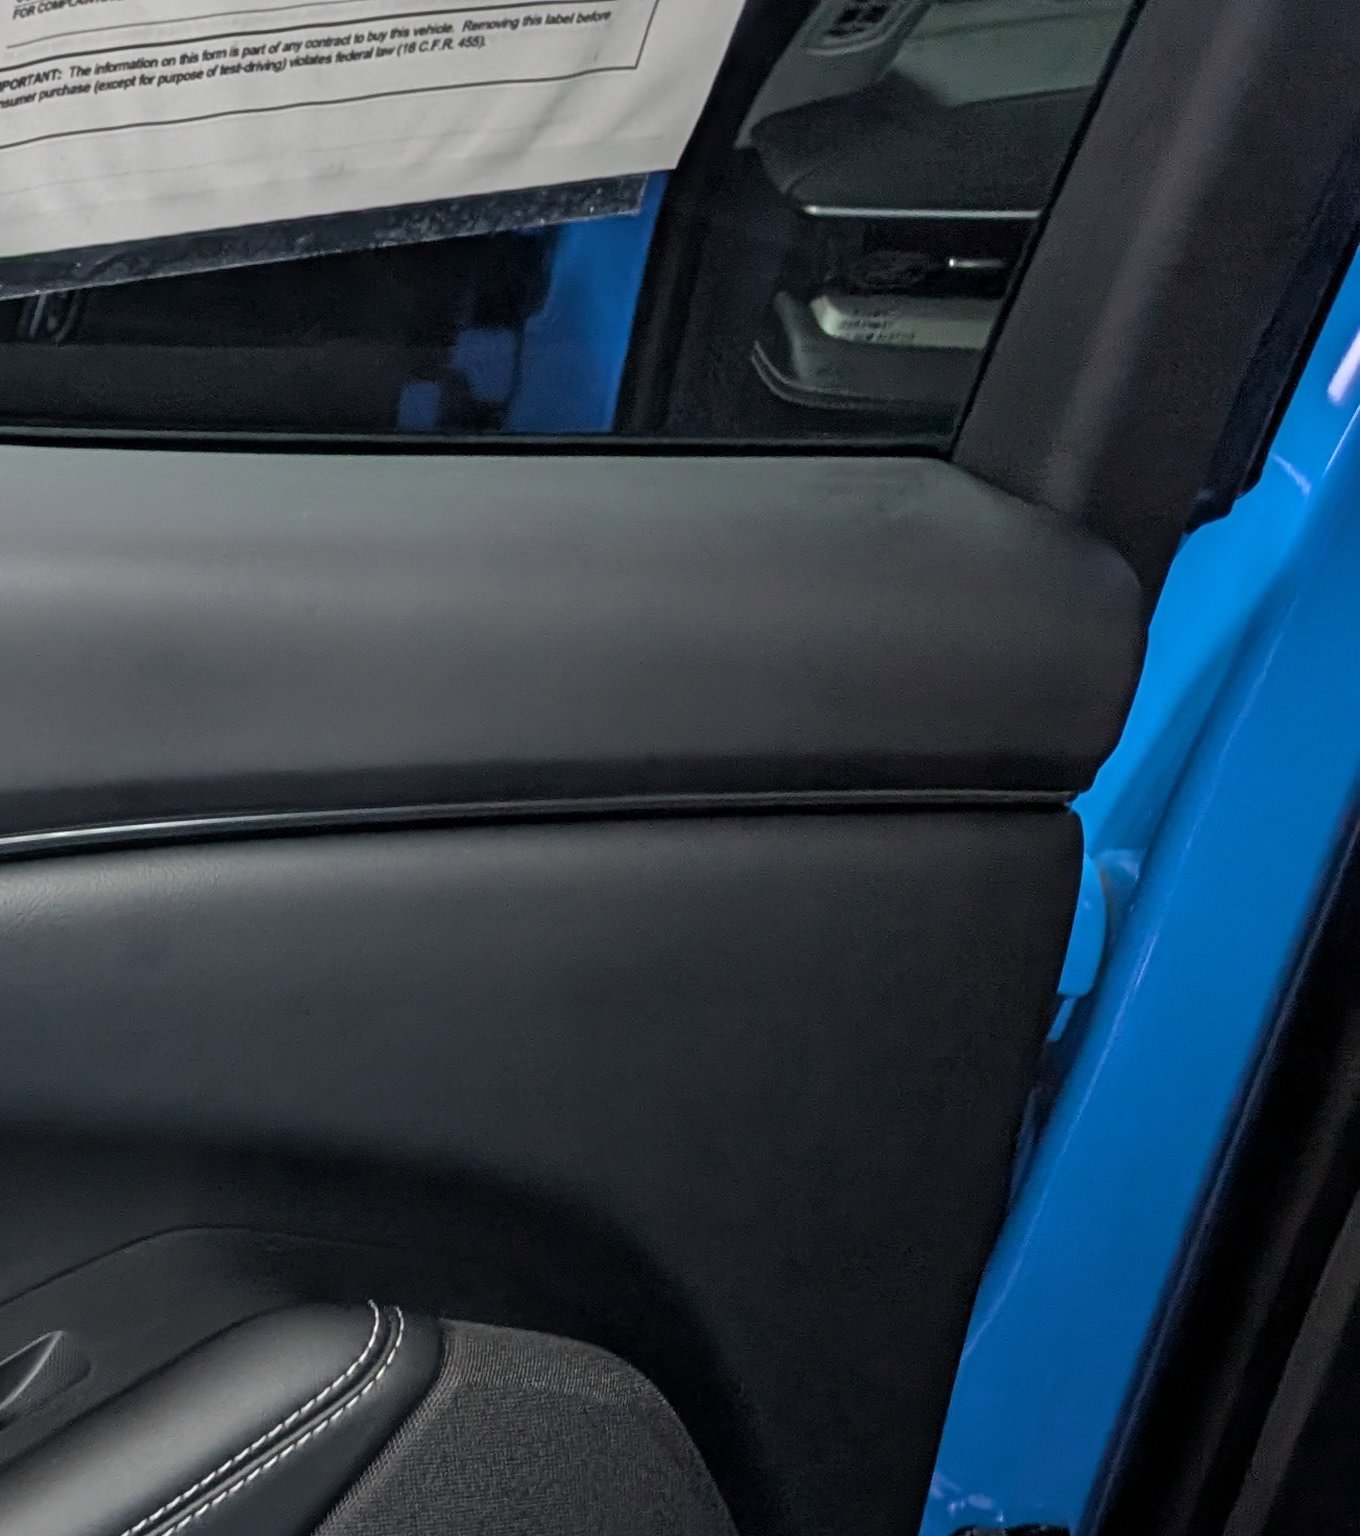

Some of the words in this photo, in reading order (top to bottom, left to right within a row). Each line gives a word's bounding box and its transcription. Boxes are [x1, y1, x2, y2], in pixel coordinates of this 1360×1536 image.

[12, 5, 36, 20] FOR
[38, 83, 91, 102] purchase
[93, 73, 136, 94] (except
[138, 74, 156, 86] for
[156, 70, 204, 87] purpose
[206, 65, 219, 78] of
[219, 58, 287, 75] test-driving)
[290, 52, 332, 68] violates
[335, 49, 373, 64] federal
[375, 48, 394, 58] law
[396, 43, 416, 57] (16
[70, 66, 92, 78] The
[94, 58, 158, 76] information
[161, 57, 176, 66] on
[179, 53, 199, 65] this
[201, 49, 227, 62] form
[229, 47, 239, 57] is
[241, 45, 266, 59] part
[268, 42, 281, 54] of
[282, 40, 301, 53] any
[304, 35, 351, 49] contract
[353, 33, 365, 44] to
[367, 30, 388, 43] buy
[390, 26, 410, 40] this
[413, 23, 454, 36] vehicle.
[462, 18, 520, 32] Removing
[522, 15, 542, 27] this
[545, 13, 574, 25] label
[576, 11, 612, 23] before
